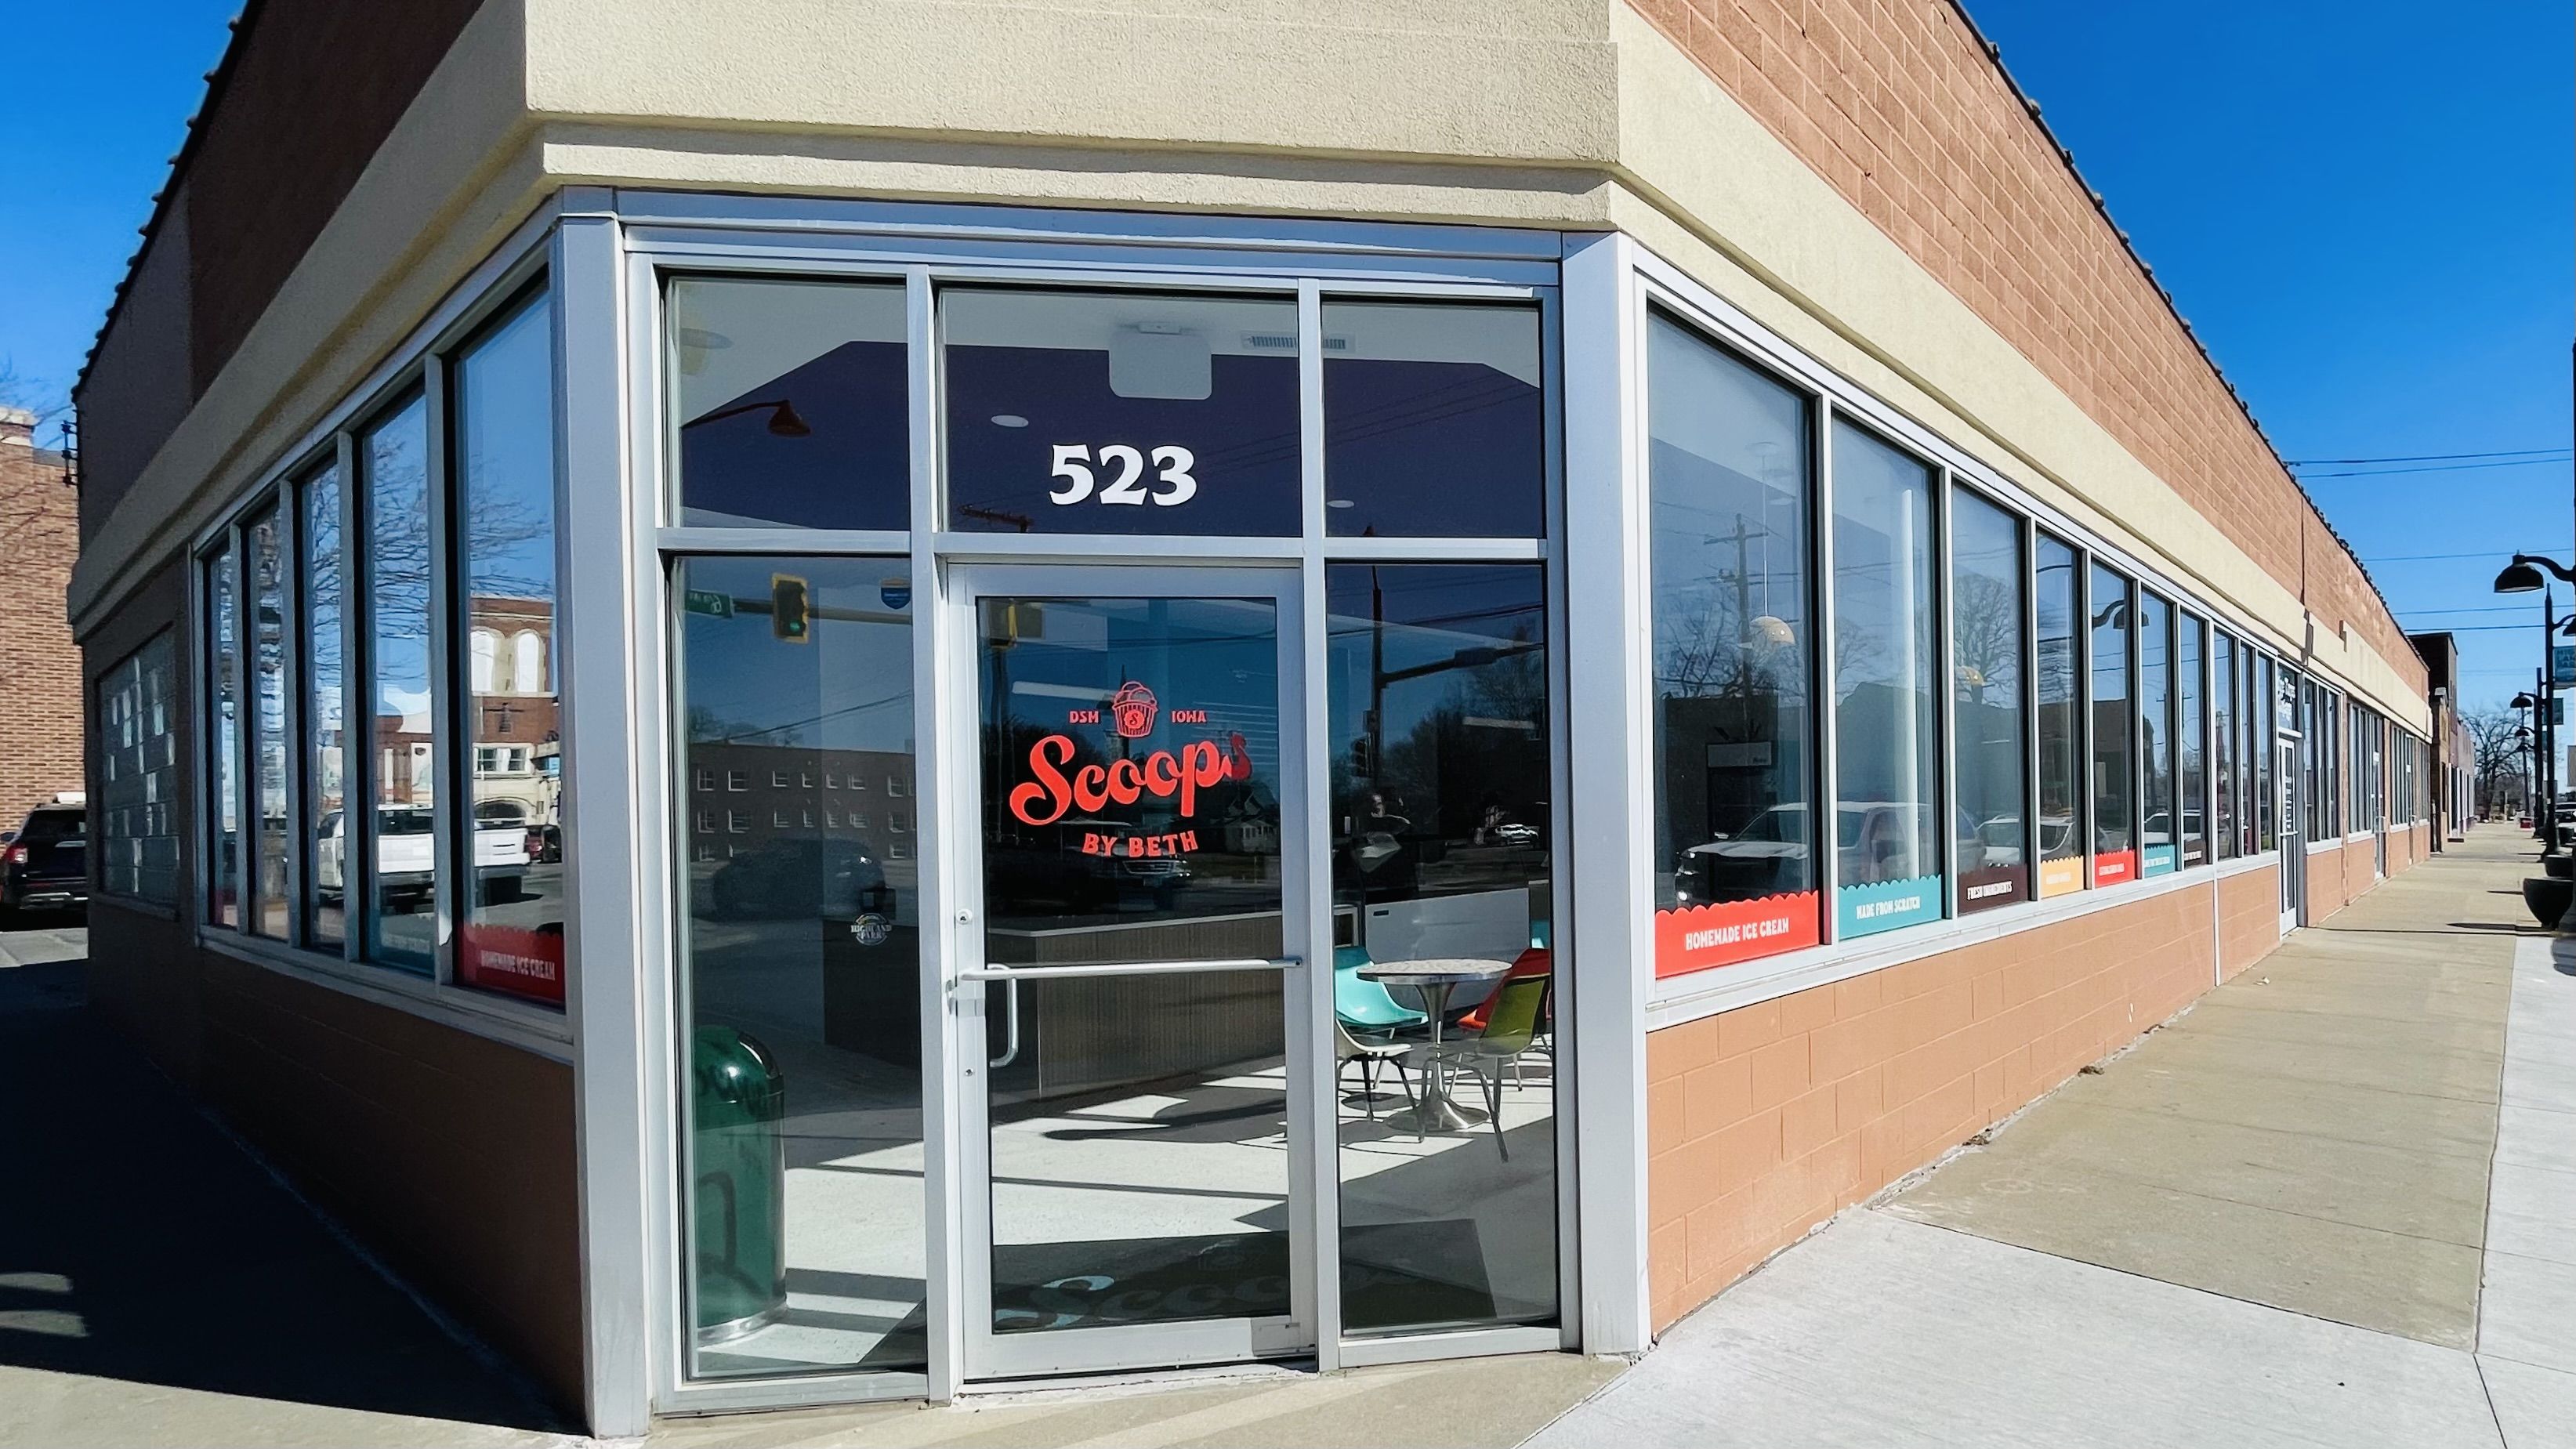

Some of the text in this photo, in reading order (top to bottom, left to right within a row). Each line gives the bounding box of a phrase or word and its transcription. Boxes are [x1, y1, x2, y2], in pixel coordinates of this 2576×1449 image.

[1049, 444, 1197, 507] 523
[1069, 710, 1207, 724] DSM IOWA
[1009, 734, 1252, 826] Scoops
[1081, 830, 1198, 858] BY BETH
[1856, 896, 1921, 920] MADE FROM SCRATCH
[1685, 917, 1790, 951] HOMEMADE ICE CREAM
[530, 958, 556, 981] CREAM
